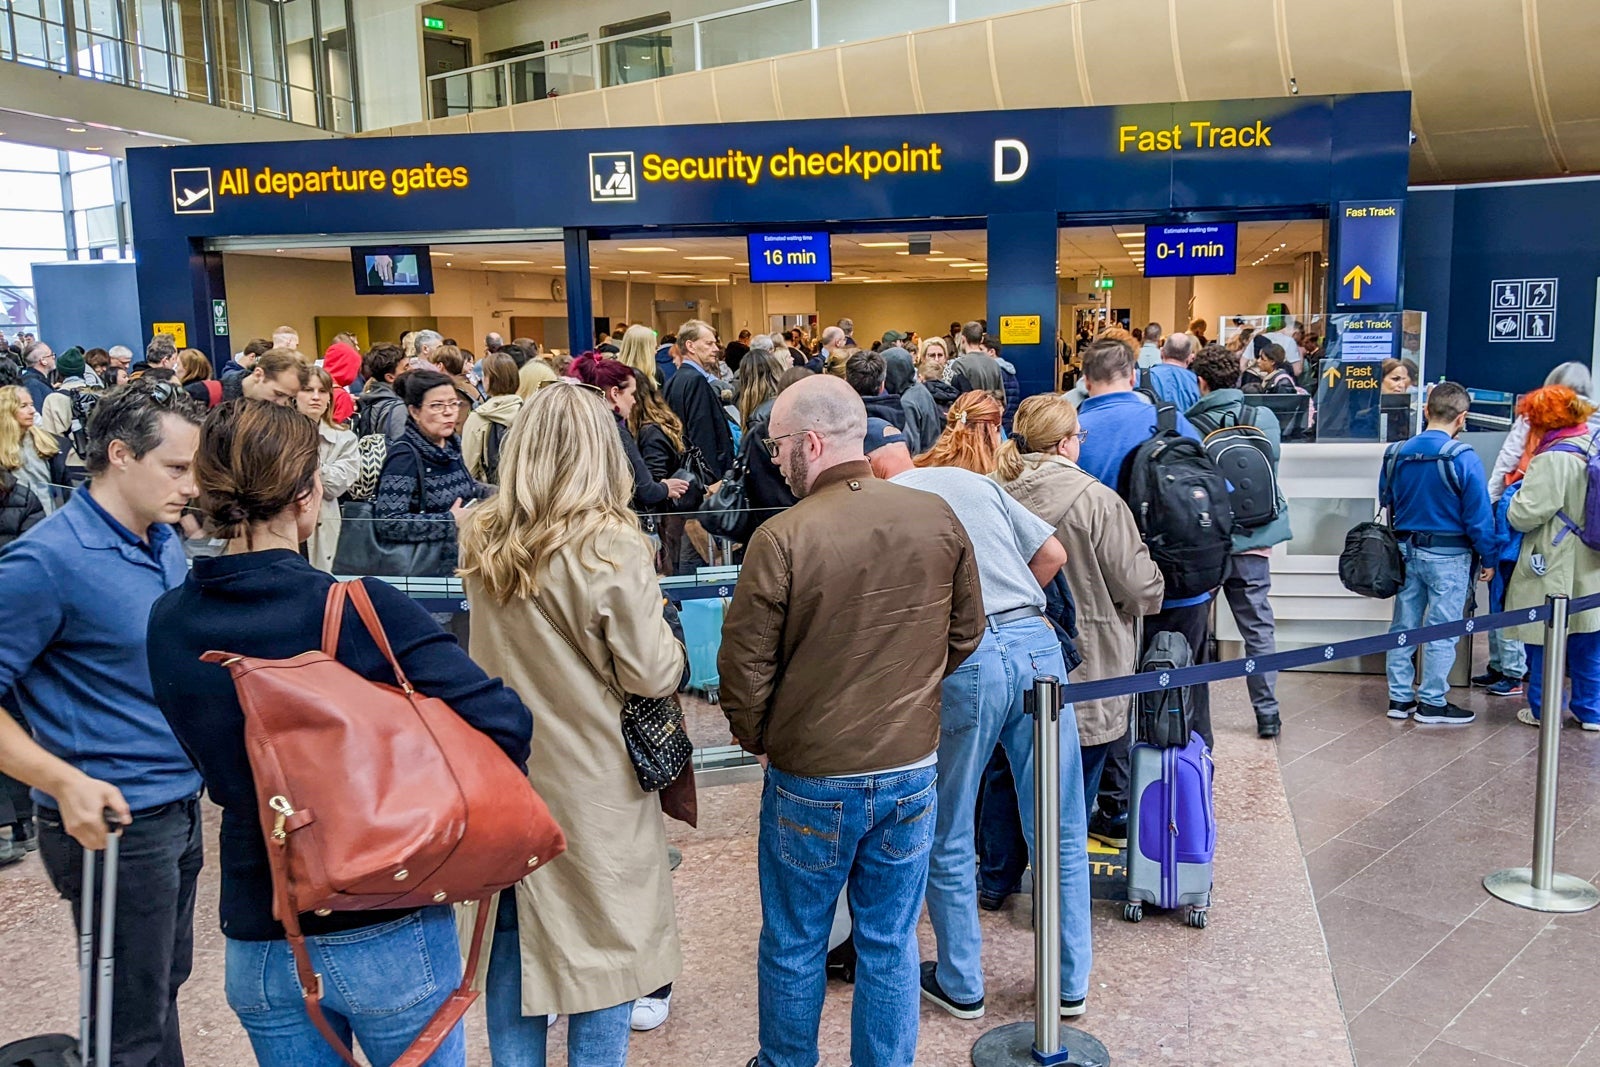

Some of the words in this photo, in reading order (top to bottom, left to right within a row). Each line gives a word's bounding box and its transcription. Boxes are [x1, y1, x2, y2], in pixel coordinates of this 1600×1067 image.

[1119, 124, 1182, 152] Fast
[1190, 120, 1272, 148] Track
[642, 149, 763, 184] Security
[769, 142, 942, 180] checkpoint
[993, 139, 1029, 183] D
[218, 168, 249, 195] All
[254, 166, 386, 199] departure
[391, 163, 468, 195] gates
[1345, 207, 1367, 217] Fast
[1369, 206, 1396, 217] Track
[763, 249, 783, 265] 16
[787, 248, 817, 265] min
[1156, 242, 1184, 259] 0-1
[1191, 241, 1224, 258] min
[1343, 320, 1364, 329] Fast
[1366, 319, 1392, 329] Track
[1345, 365, 1372, 377] Fast
[1345, 378, 1378, 389] Track
